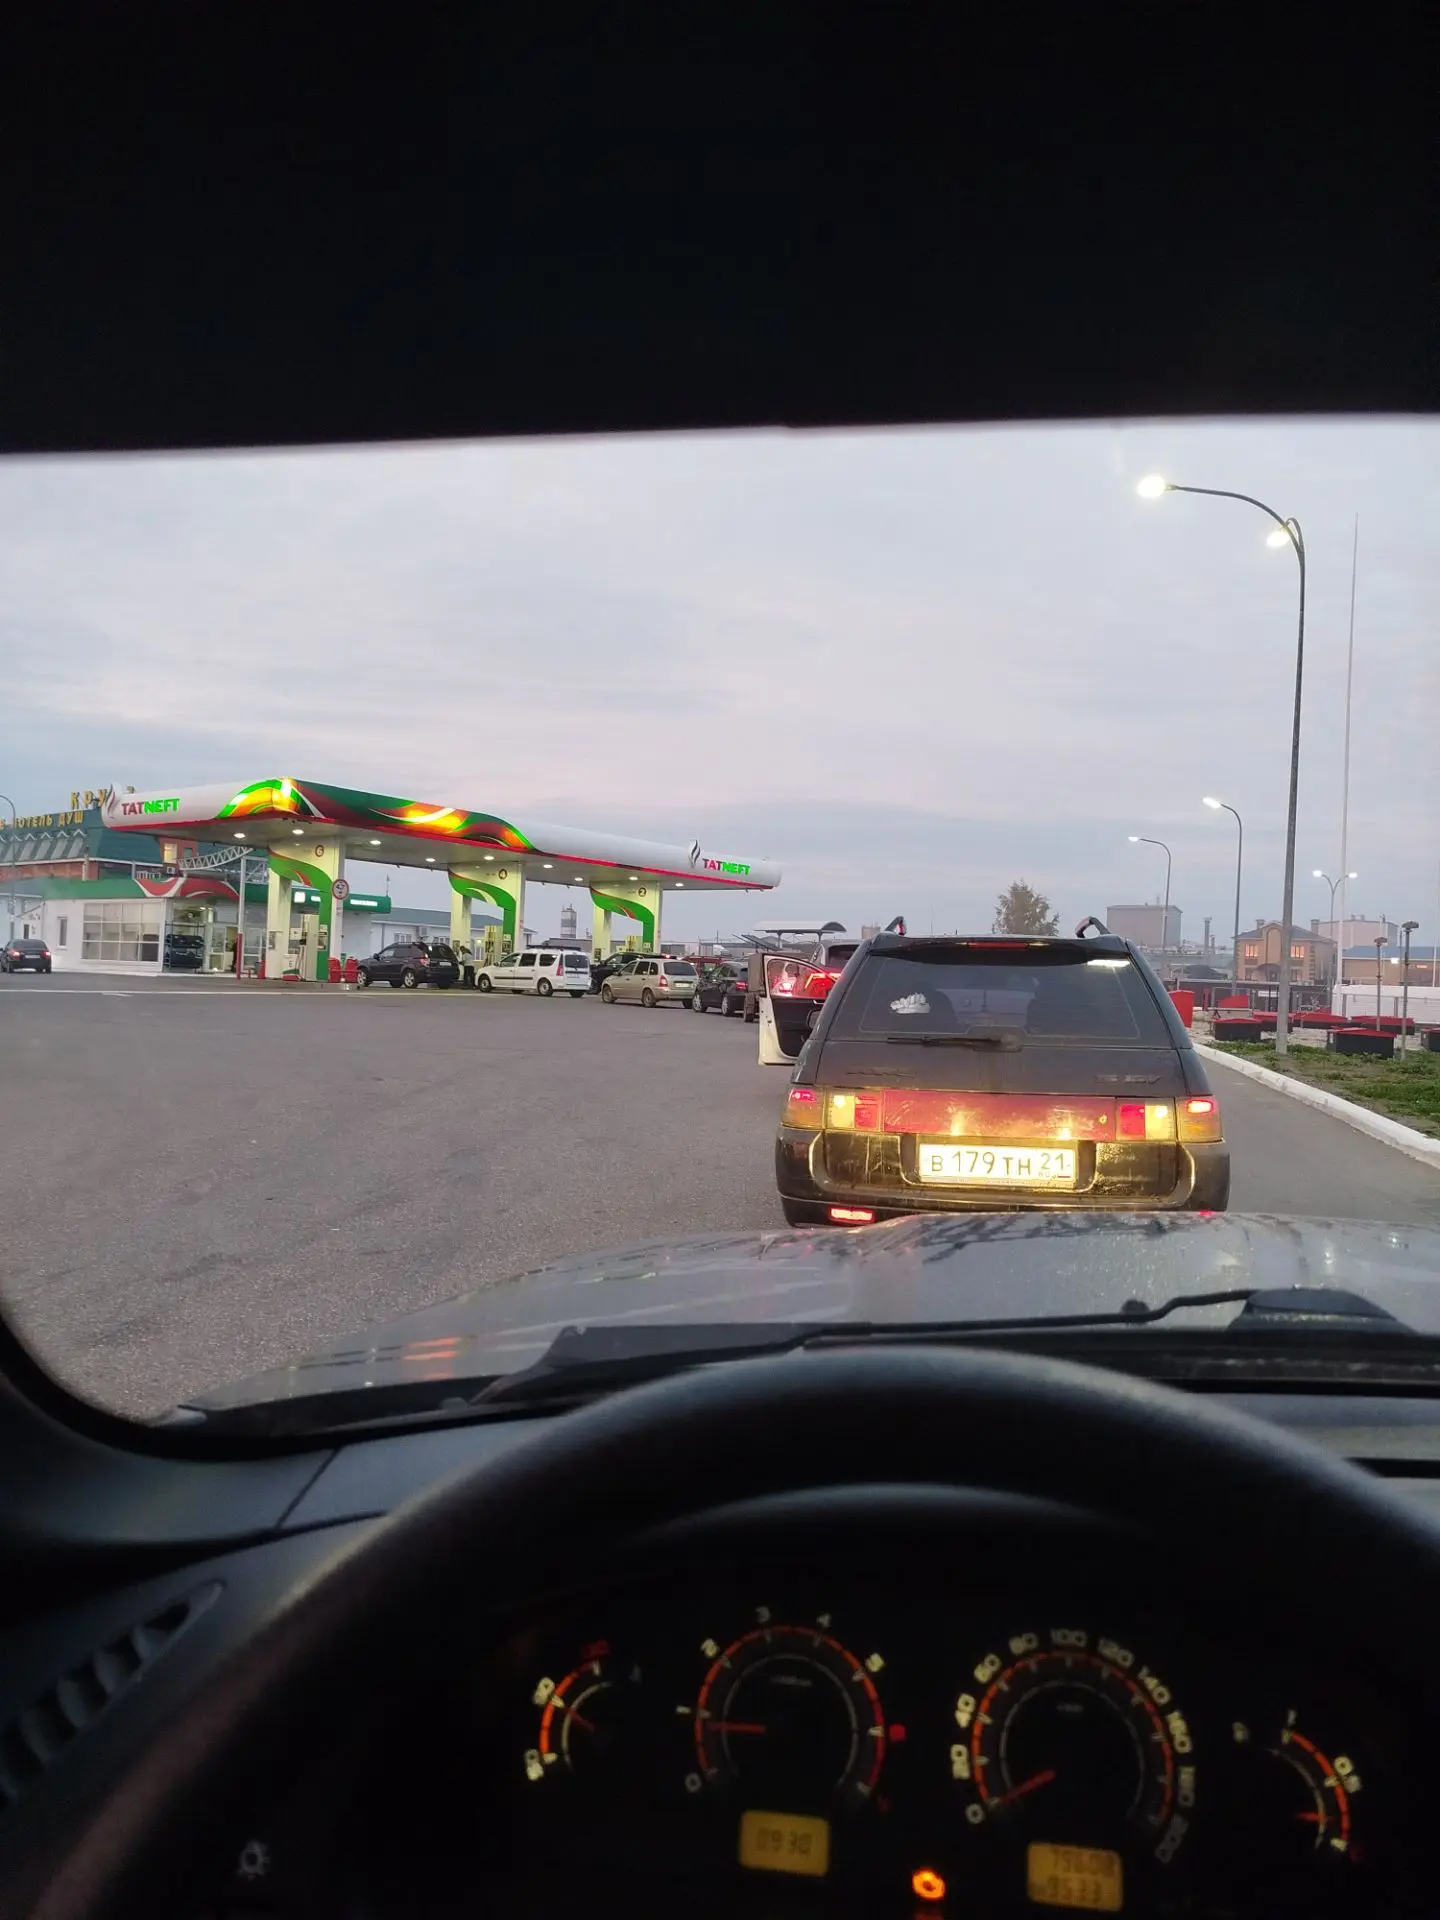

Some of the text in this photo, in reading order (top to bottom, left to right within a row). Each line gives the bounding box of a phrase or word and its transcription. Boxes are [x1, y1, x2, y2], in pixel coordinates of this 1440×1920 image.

[121, 798, 180, 816] TATNEFT
[58, 810, 84, 827] ДУШ
[702, 858, 751, 875] TATNEFT
[1050, 1627, 1088, 1648] 100
[1097, 1636, 1135, 1669] 120
